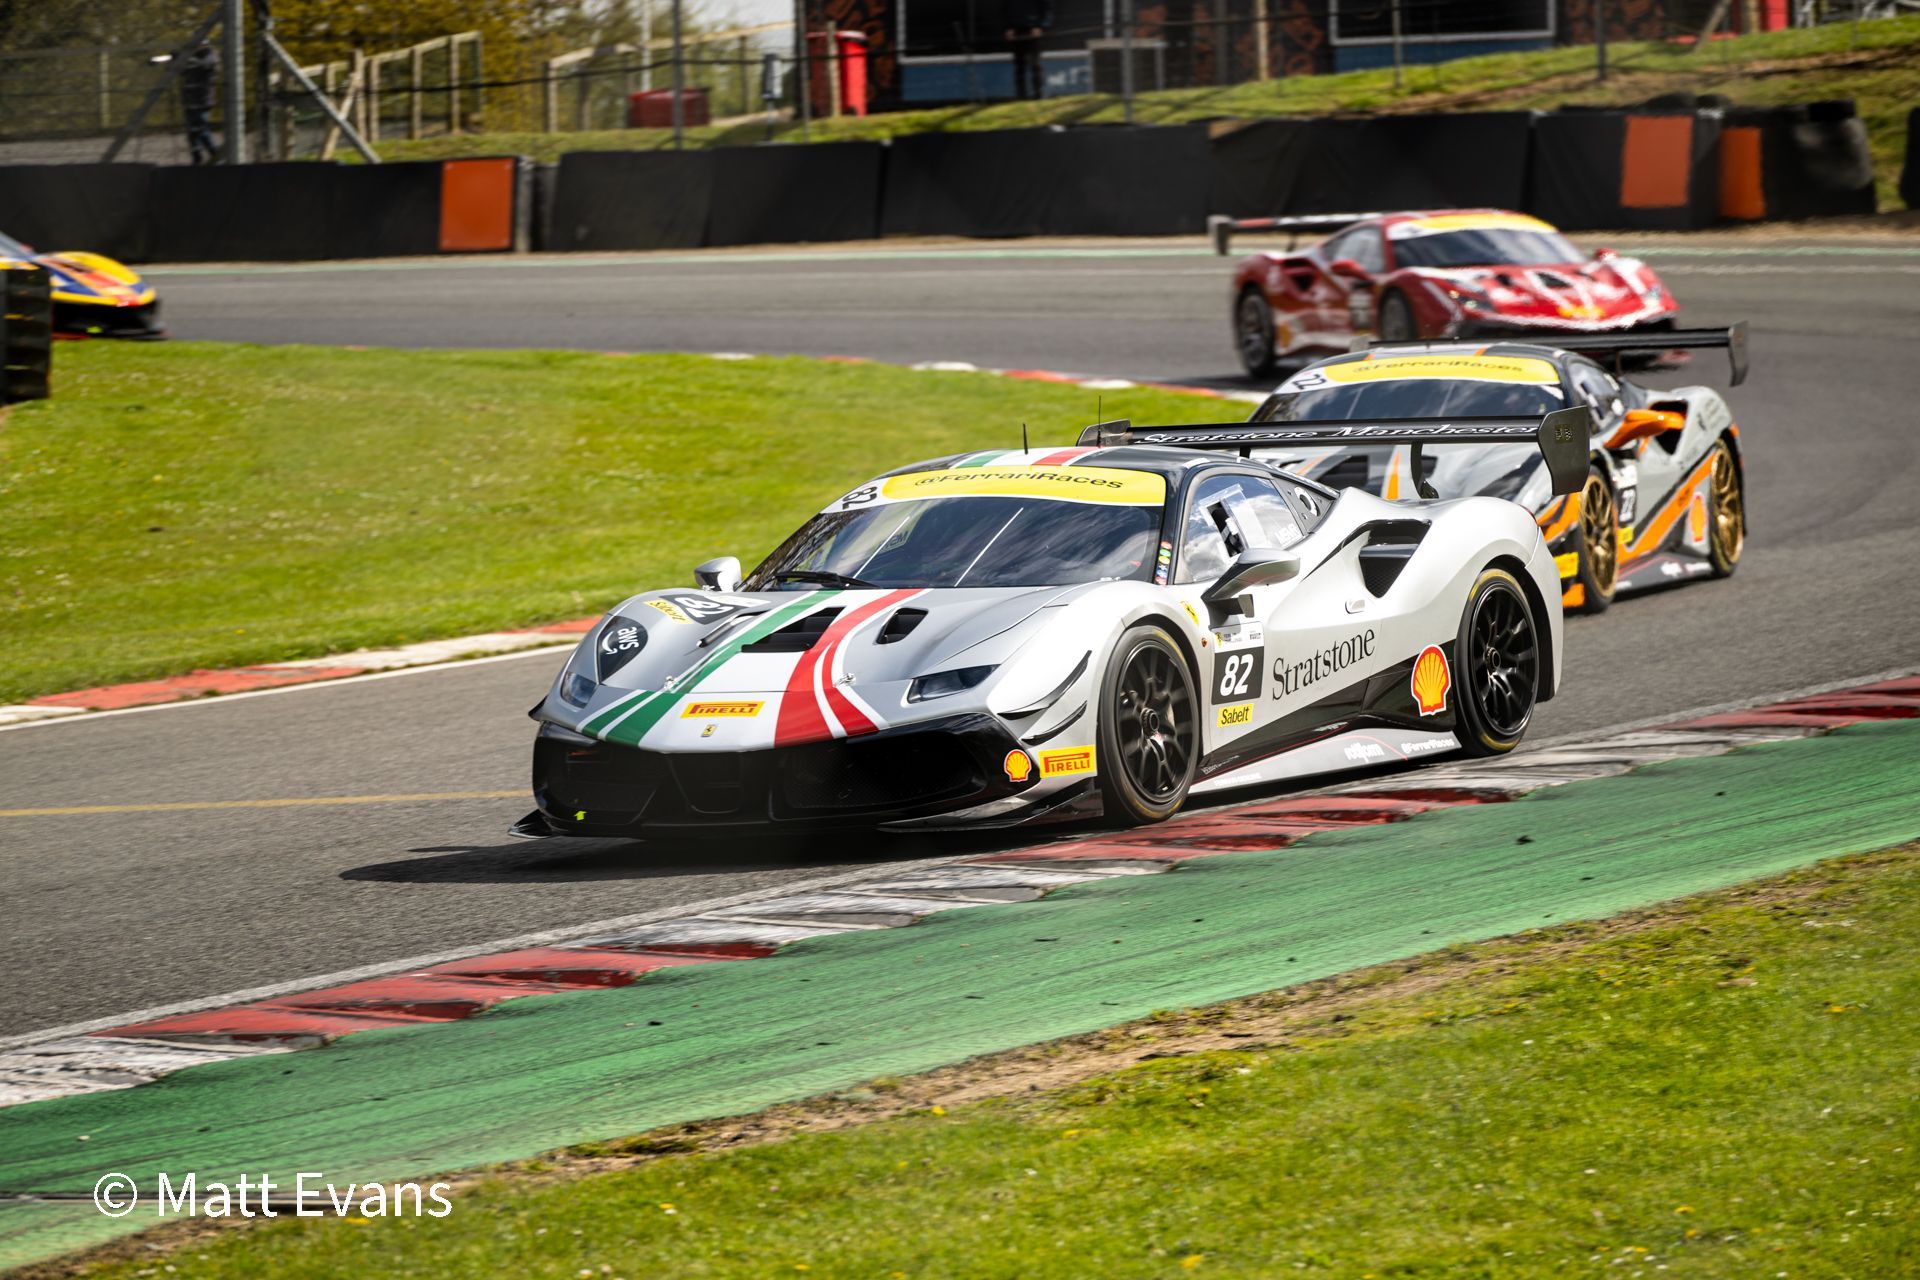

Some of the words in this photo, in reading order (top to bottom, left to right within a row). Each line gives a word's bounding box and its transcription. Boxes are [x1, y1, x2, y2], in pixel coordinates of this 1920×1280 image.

[1292, 373, 1327, 390] 22
[1135, 430, 1318, 444] Stratstone
[1328, 424, 1539, 437] Manchester
[842, 486, 877, 510] 82
[914, 471, 1124, 490] @FerrariRaces
[674, 597, 734, 618] 82
[617, 626, 640, 651] aws
[1220, 653, 1254, 697] 82
[1272, 628, 1376, 701] Stratstone
[688, 703, 758, 715] PIRELLI
[1221, 705, 1250, 725] Sabelt
[1044, 752, 1090, 773] PIRELLI
